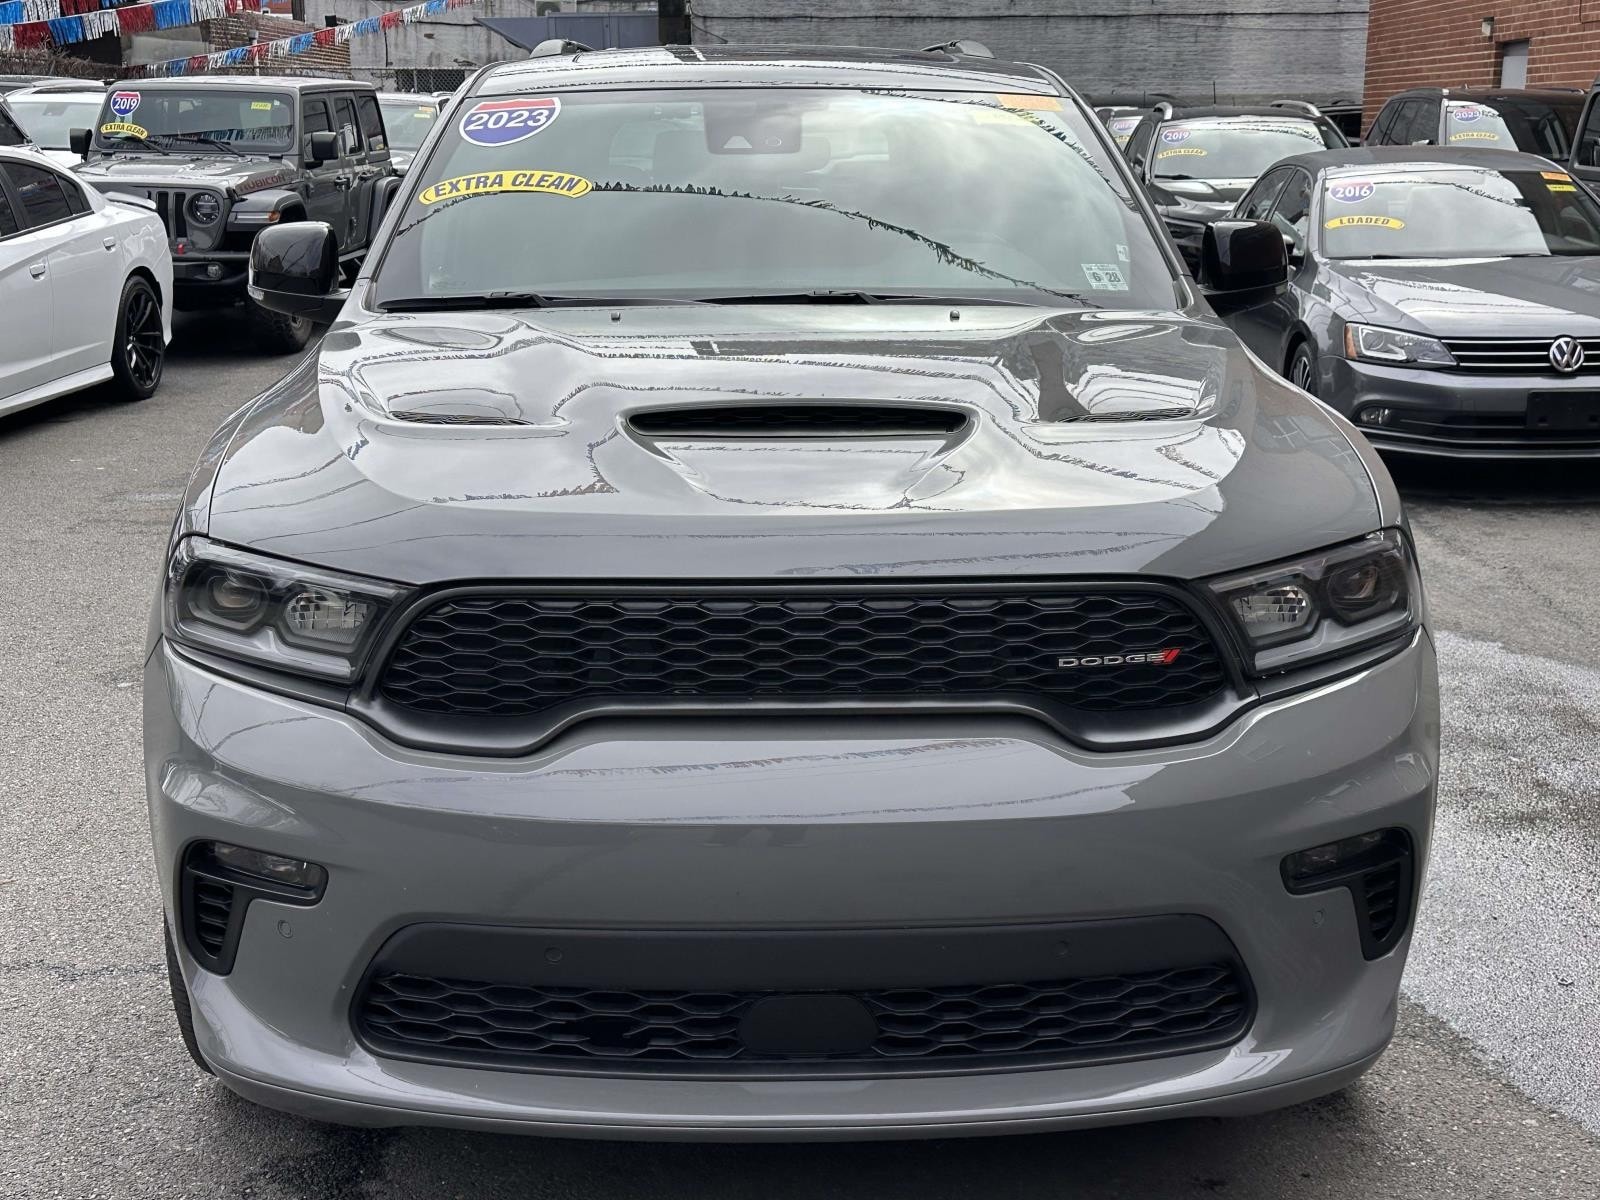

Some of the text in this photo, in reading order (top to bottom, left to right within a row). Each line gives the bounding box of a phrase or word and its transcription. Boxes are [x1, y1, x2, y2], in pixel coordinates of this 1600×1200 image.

[114, 98, 138, 110] 2019
[465, 109, 550, 131] 2023
[105, 123, 145, 136] EXTRA CLEAN
[1166, 131, 1190, 140] 2019
[240, 174, 286, 192] RUBICON
[433, 173, 583, 198] EXTRA CLEAN
[1335, 185, 1371, 198] 2016
[1339, 216, 1390, 225] LOADED
[1092, 271, 1101, 282] 6
[1058, 653, 1165, 667] DODGE
